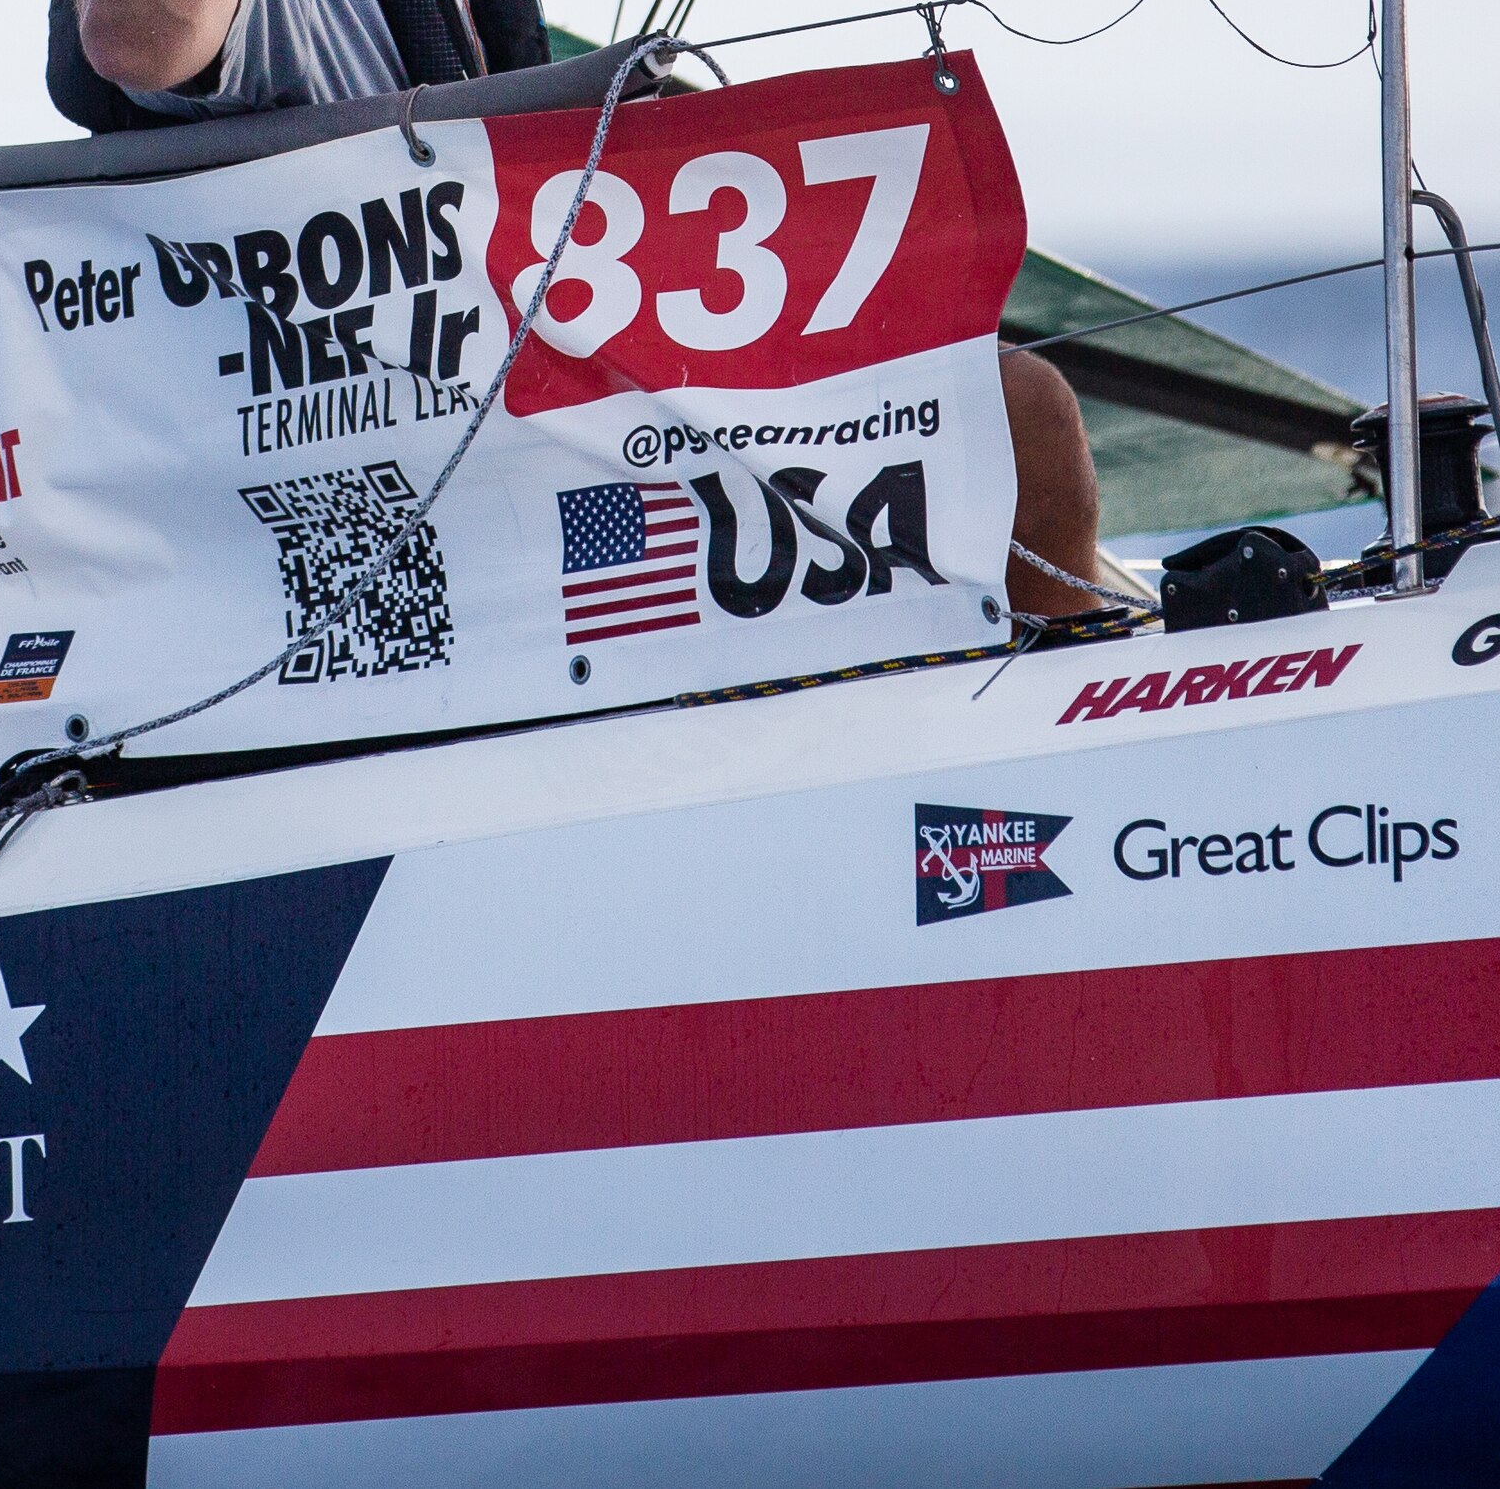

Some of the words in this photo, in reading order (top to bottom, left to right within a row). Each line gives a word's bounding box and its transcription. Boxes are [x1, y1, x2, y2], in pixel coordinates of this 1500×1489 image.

[512, 123, 930, 359] 837
[24, 258, 141, 333] Peter
[237, 377, 397, 457] TERMINAL
[411, 374, 481, 422] LEA
[622, 398, 940, 468] @pgceanracing
[691, 460, 951, 620] USA
[0, 668, 15, 677] DE
[15, 665, 56, 676] FRANCE
[1055, 643, 1363, 726] HARKEN
[952, 820, 1036, 846] YANKEE
[980, 847, 1036, 865] MARINE
[1113, 819, 1295, 881] Great
[1308, 803, 1460, 883] Clips
